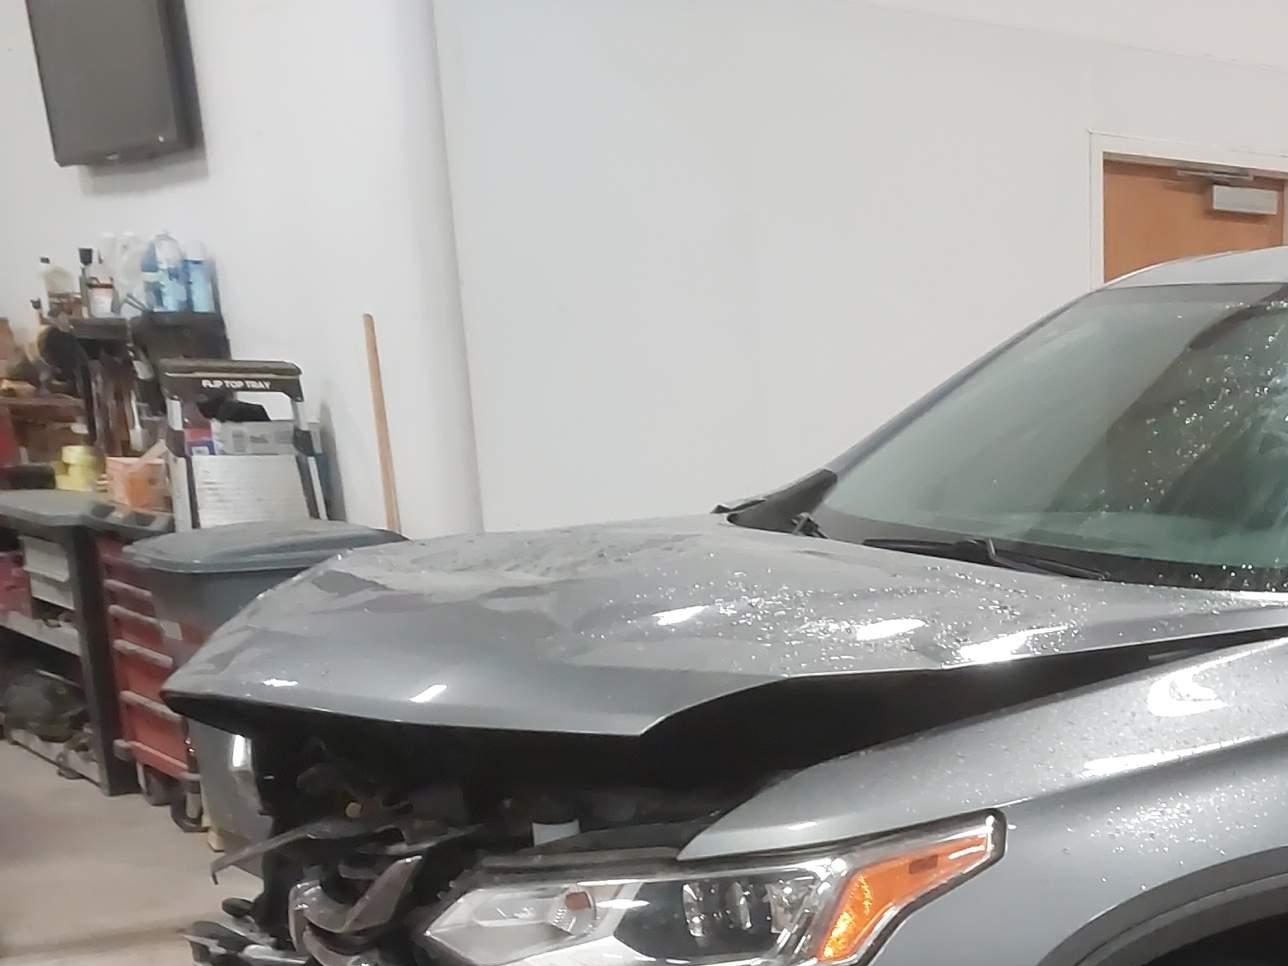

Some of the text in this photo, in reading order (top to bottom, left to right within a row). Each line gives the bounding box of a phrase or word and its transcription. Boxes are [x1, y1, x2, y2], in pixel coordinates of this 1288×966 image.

[201, 379, 272, 390] FLIP TOP TRAY
